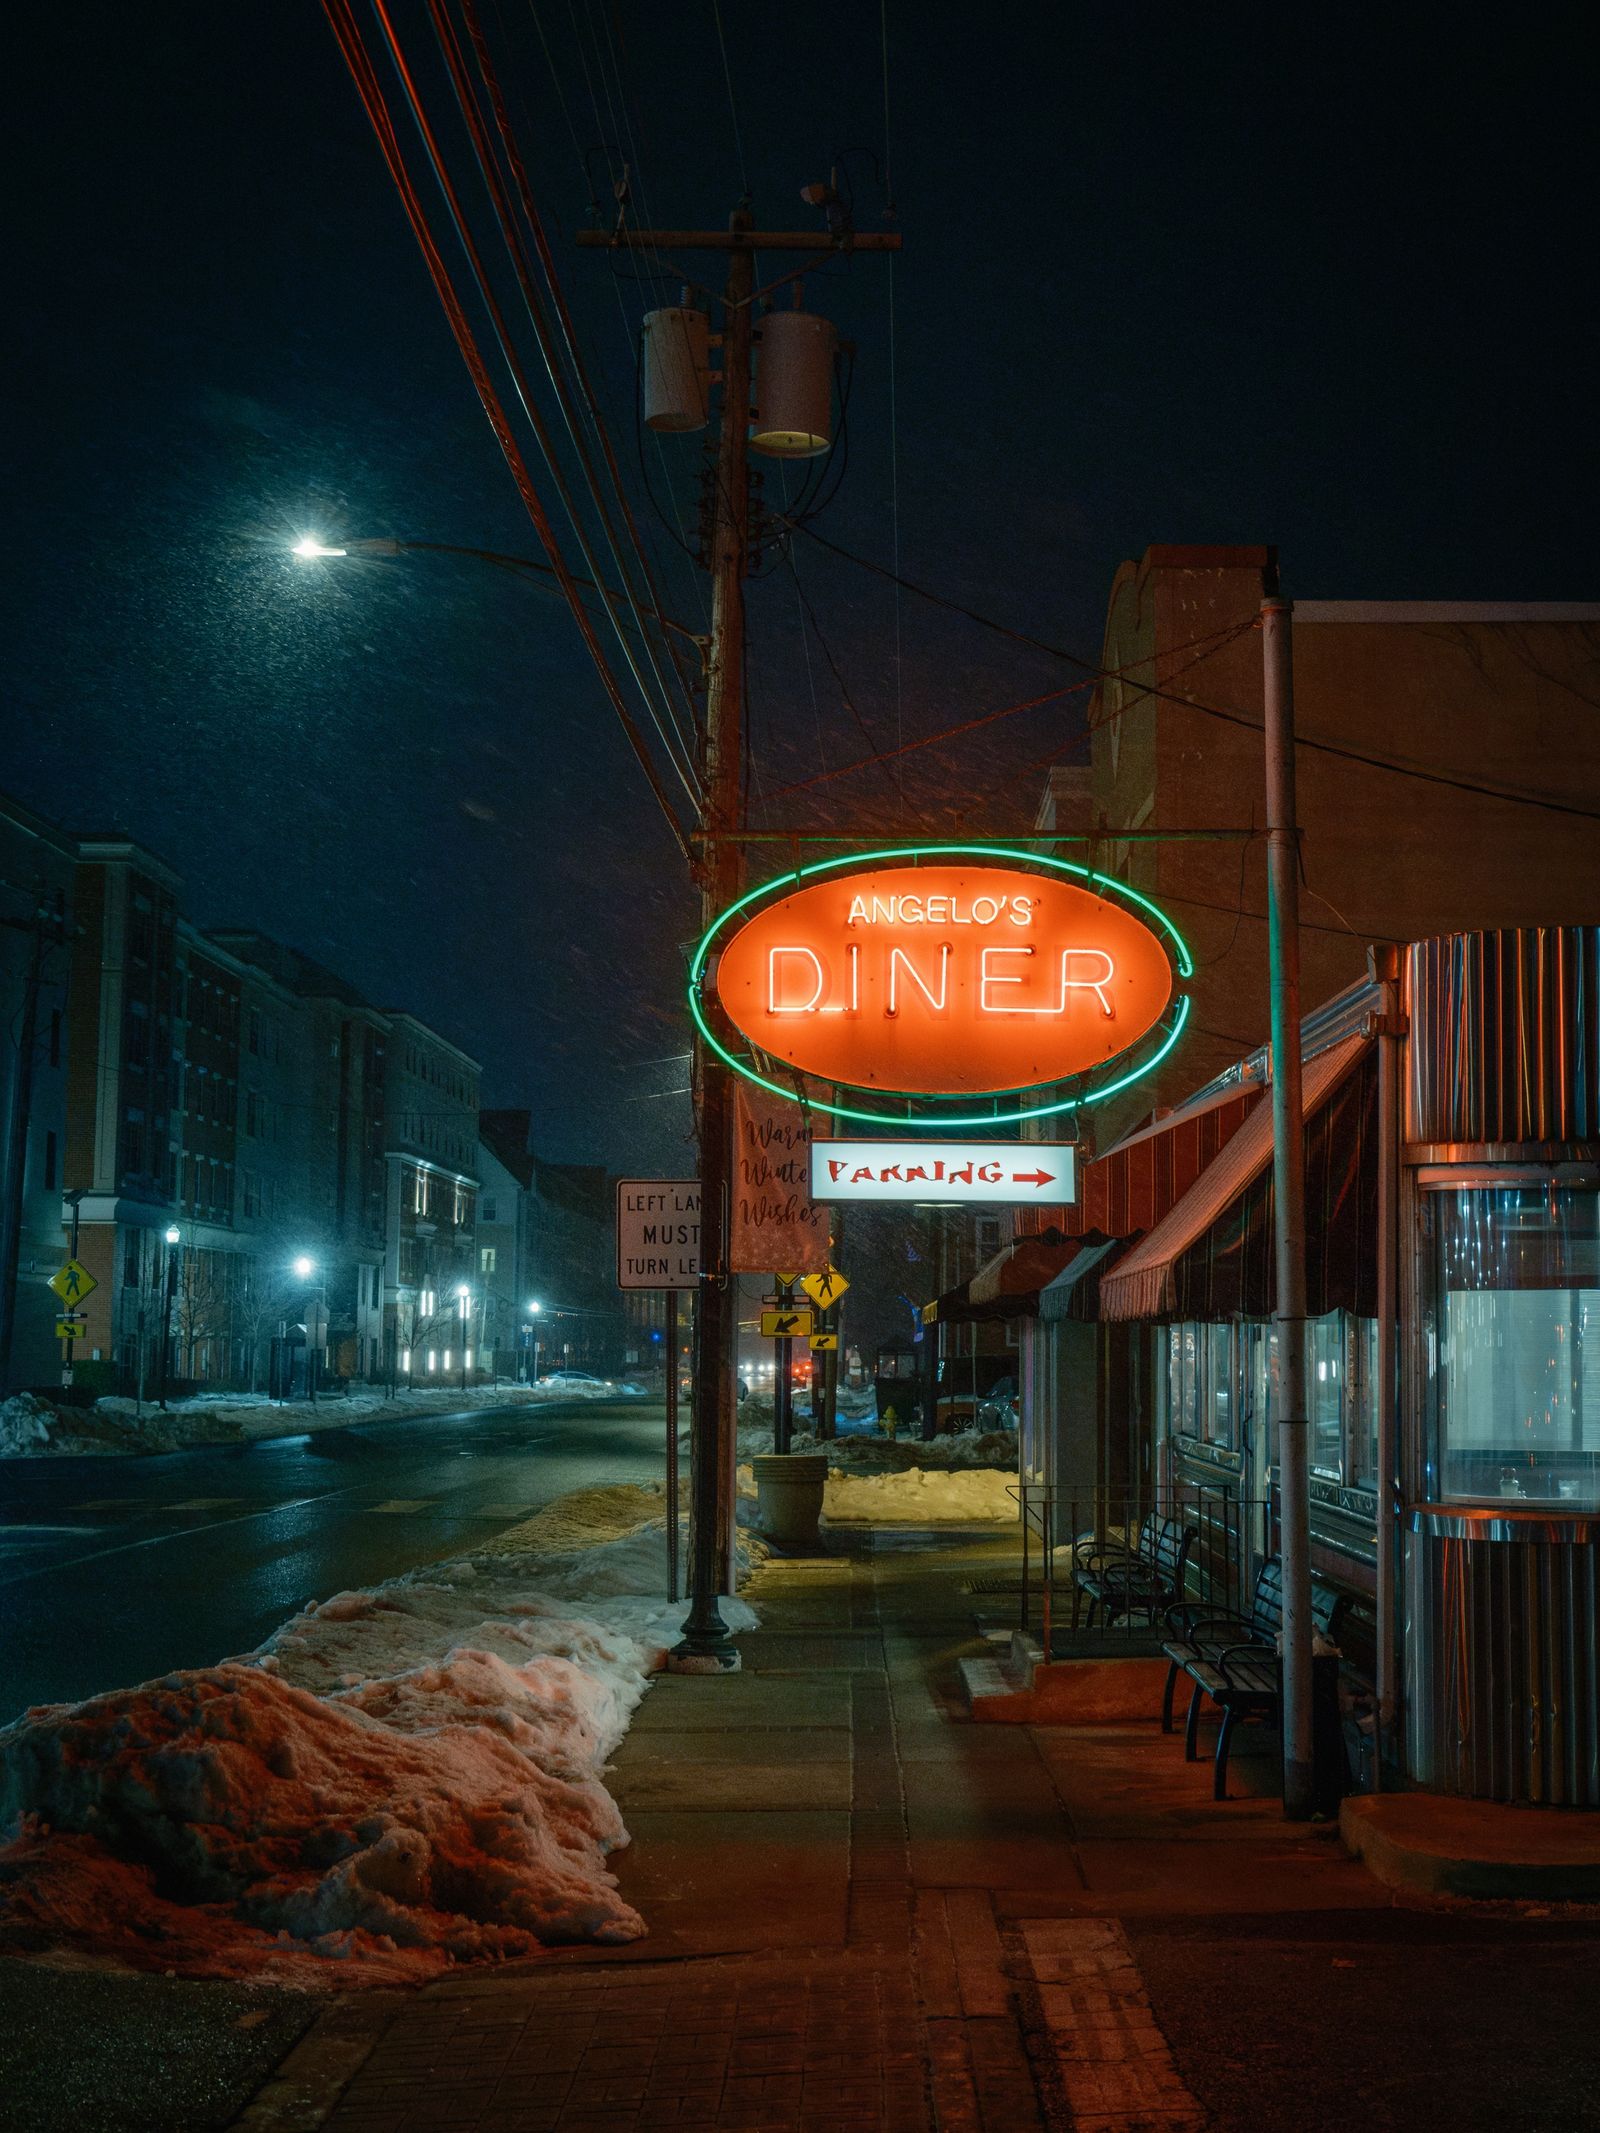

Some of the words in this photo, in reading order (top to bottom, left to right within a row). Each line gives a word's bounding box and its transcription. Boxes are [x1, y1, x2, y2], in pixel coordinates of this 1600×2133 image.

[848, 895, 1033, 926] ANGELO'S
[766, 945, 1117, 1017] DINER
[740, 1156, 808, 1187] Winte
[627, 1195, 666, 1211] LEFT
[740, 1194, 821, 1227] Wishes
[643, 1225, 700, 1244] MUST
[626, 1259, 669, 1275] TURN
